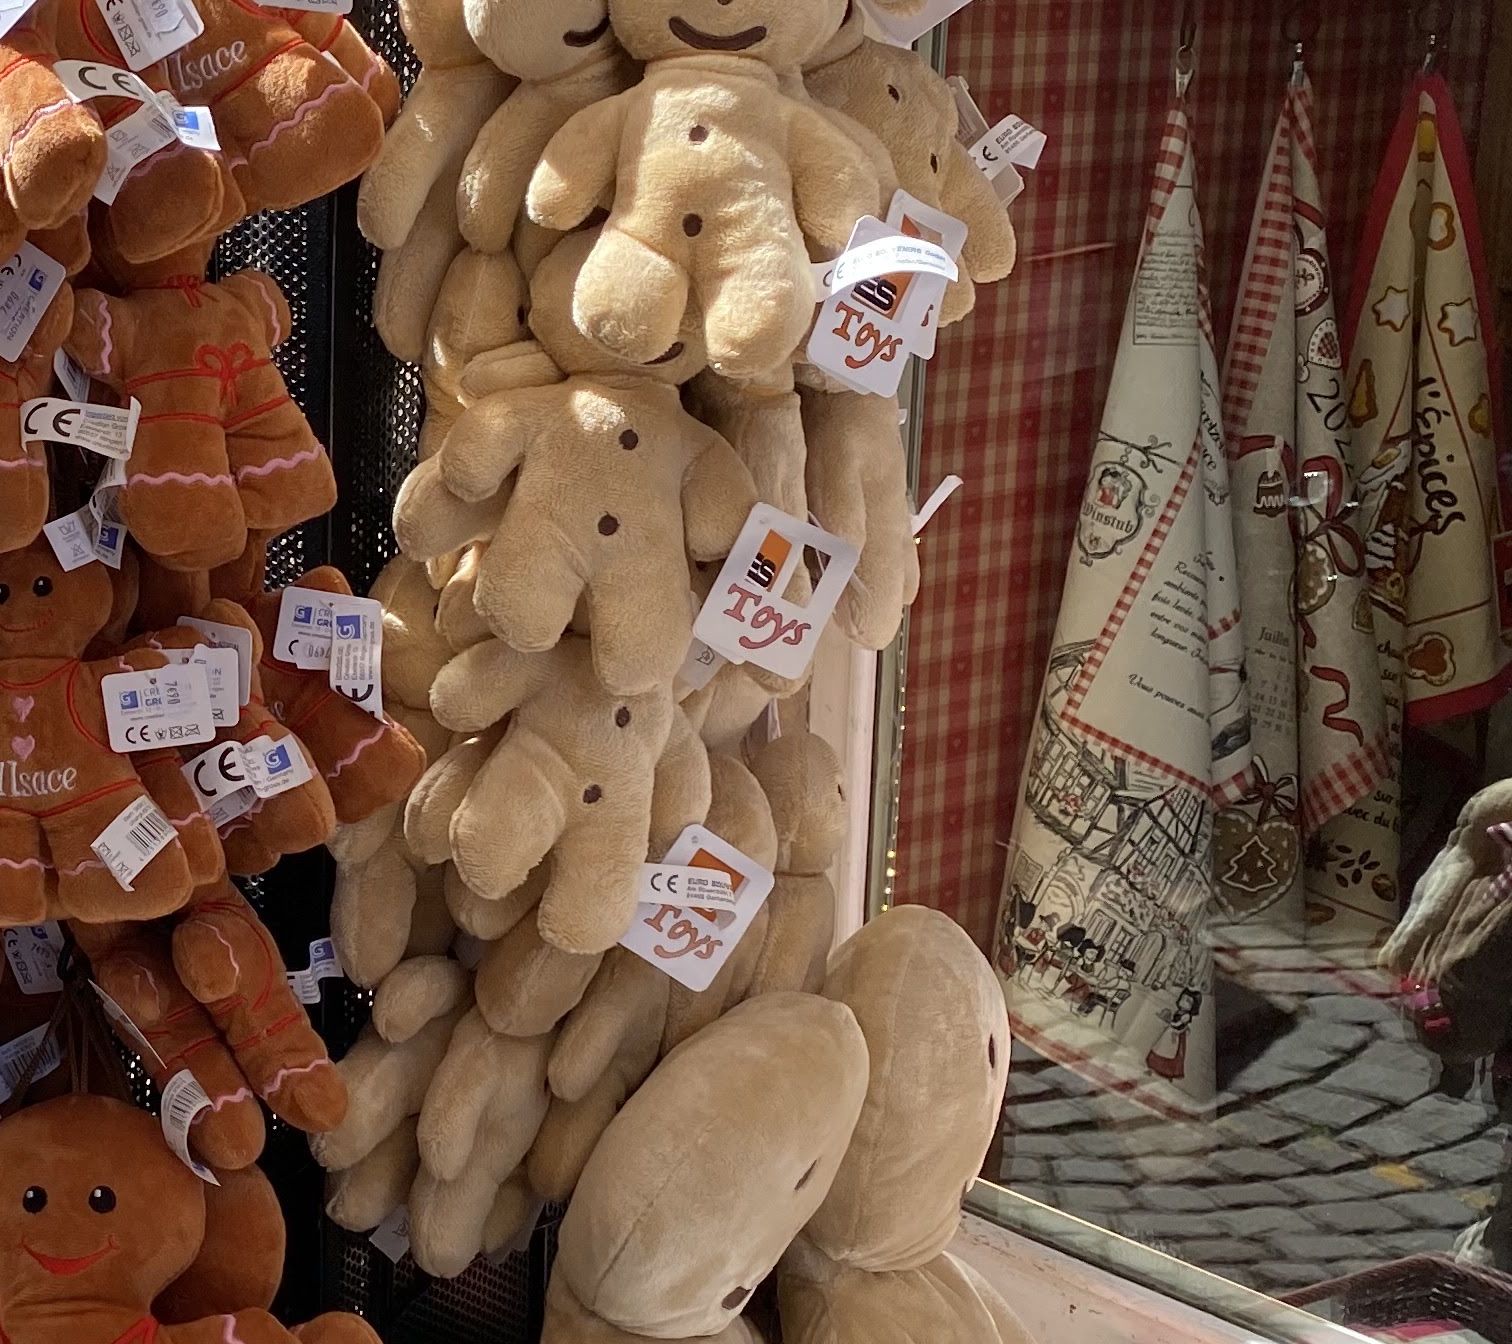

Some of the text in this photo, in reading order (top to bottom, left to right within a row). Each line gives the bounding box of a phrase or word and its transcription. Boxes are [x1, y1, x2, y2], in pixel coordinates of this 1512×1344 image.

[832, 300, 903, 369] Toys
[23, 401, 81, 438] CE
[723, 583, 812, 650] Toys
[125, 725, 151, 744] CE
[193, 746, 246, 797] CE
[650, 872, 679, 894] CE
[643, 902, 724, 960] Toys
